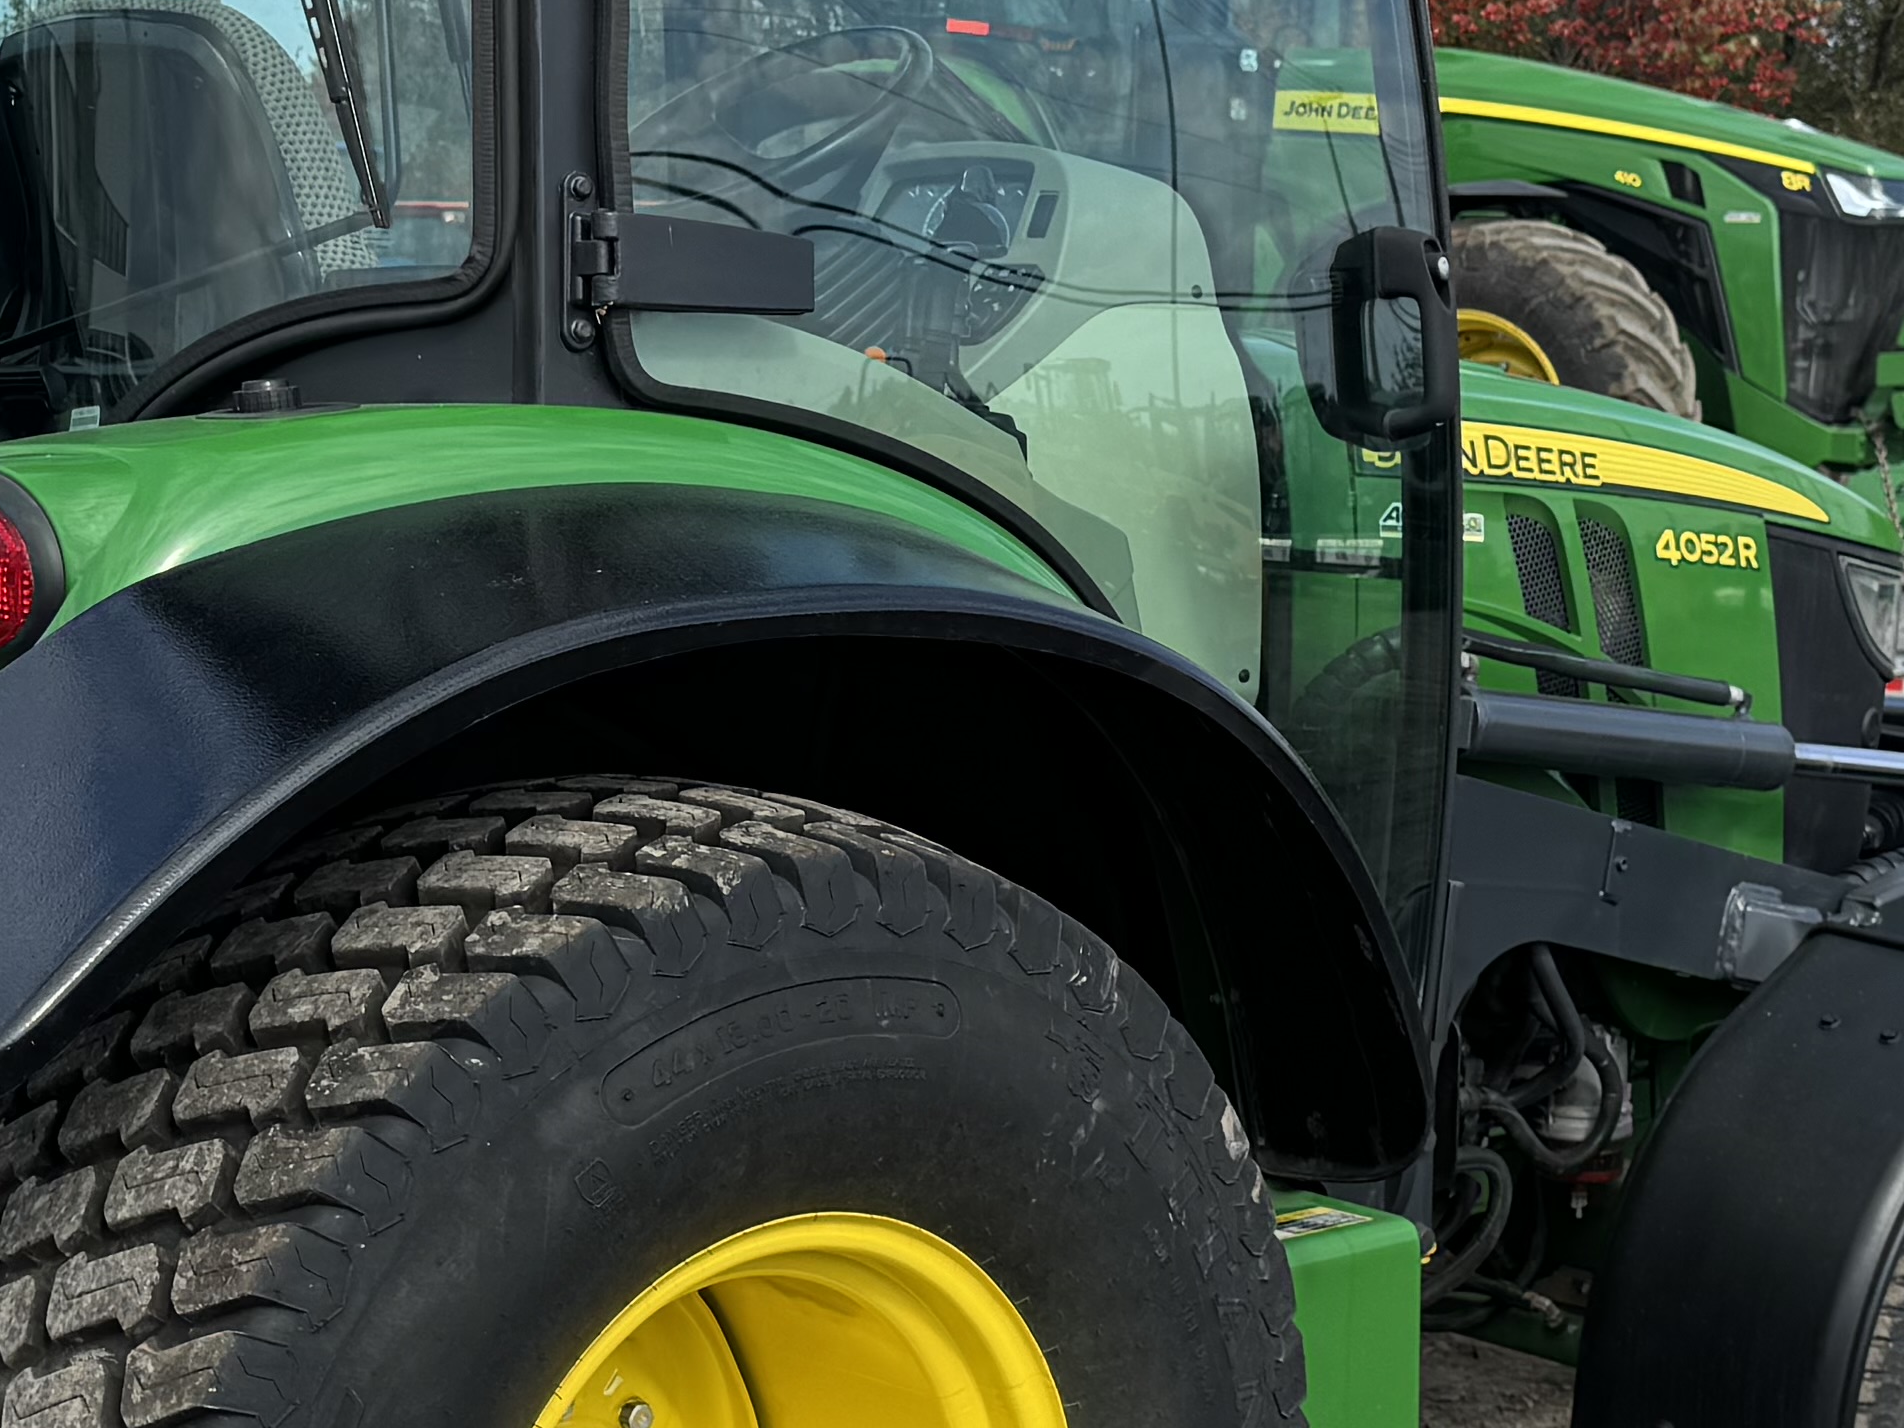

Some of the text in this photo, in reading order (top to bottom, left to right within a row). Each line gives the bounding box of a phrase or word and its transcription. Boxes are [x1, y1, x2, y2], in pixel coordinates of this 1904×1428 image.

[1283, 100, 1379, 121] JOHN DEE
[1484, 433, 1601, 483] DEERE
